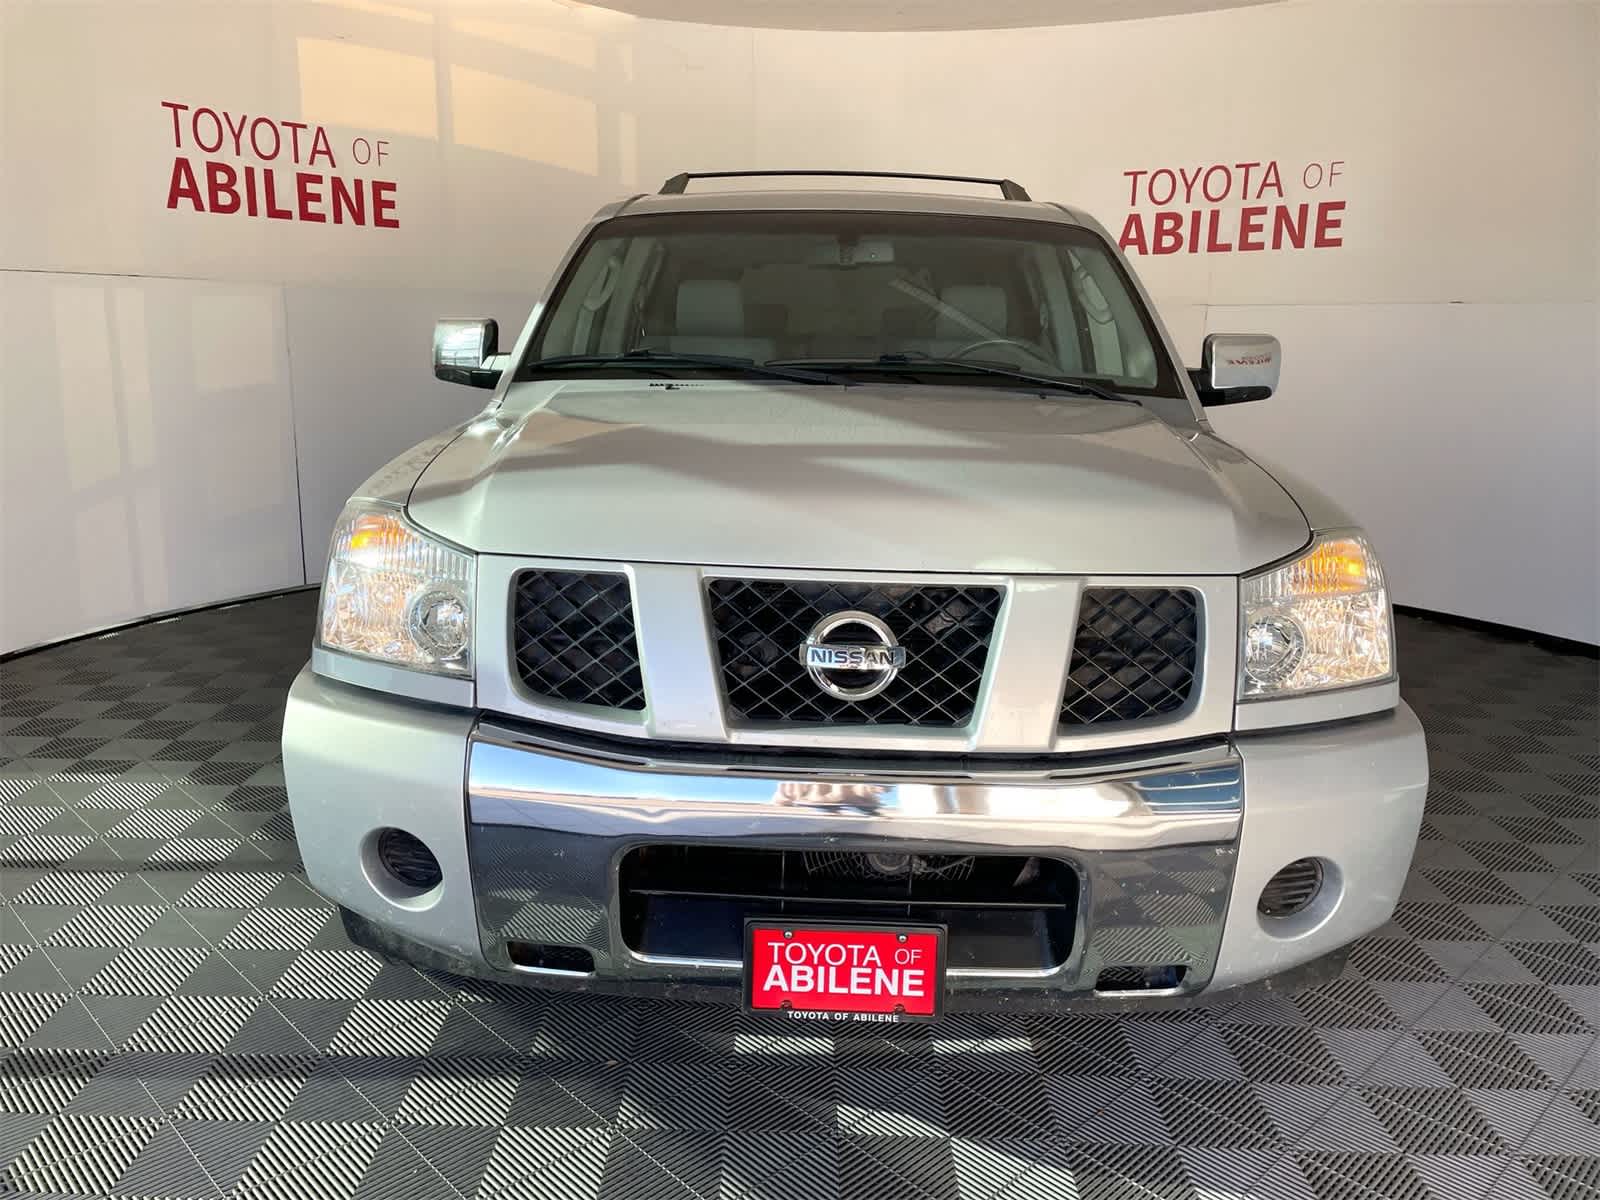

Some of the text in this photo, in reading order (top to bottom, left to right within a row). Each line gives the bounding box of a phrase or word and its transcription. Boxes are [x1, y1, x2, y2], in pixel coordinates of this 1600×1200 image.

[161, 101, 390, 169] TOYOTA OF
[166, 156, 400, 229] ABILENE
[1123, 160, 1345, 207] TOYOTA OF
[1118, 200, 1346, 256] ABILENE
[811, 648, 894, 666] NISSAN
[767, 942, 923, 967] TOYOTA OF
[762, 964, 925, 997] ABILENE
[787, 1011, 899, 1023] TOYOTA OF ABILENE
